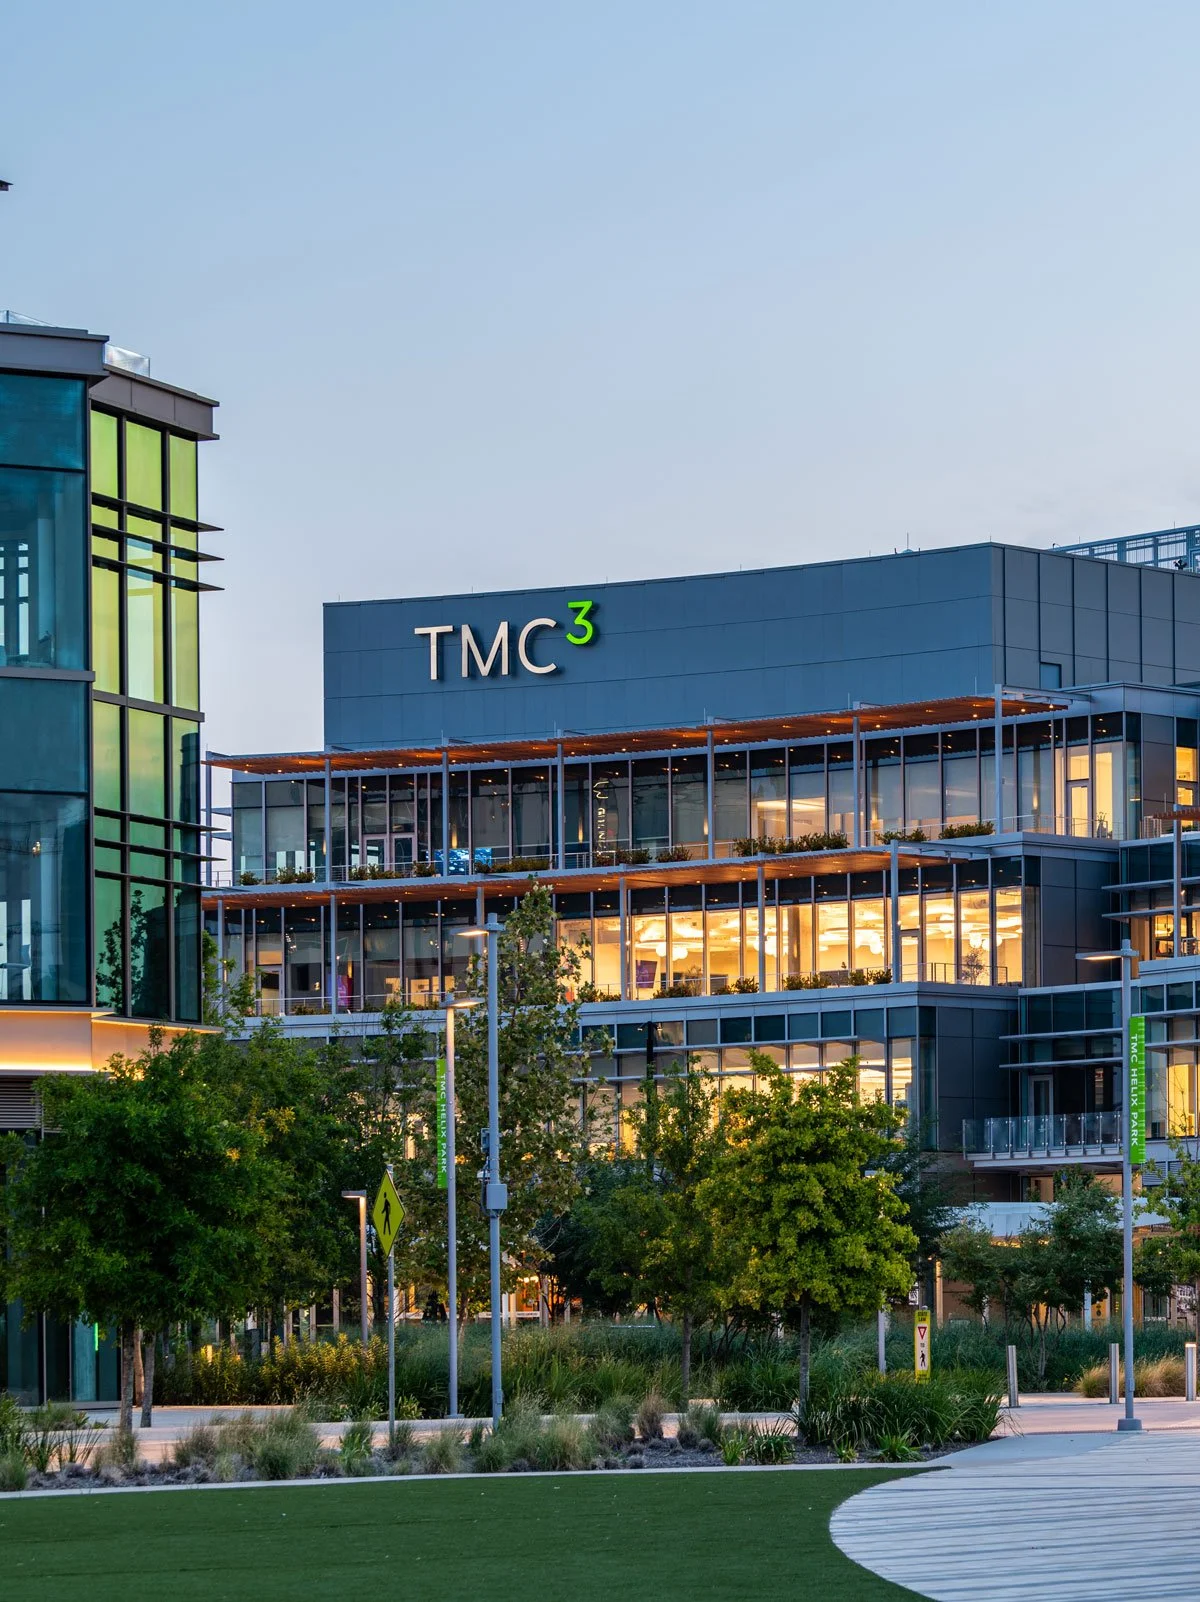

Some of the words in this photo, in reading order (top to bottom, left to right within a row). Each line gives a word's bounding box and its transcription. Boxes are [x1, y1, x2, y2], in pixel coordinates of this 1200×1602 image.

[1130, 1034, 1138, 1063] TMC
[1130, 1068, 1138, 1106] HELIX
[1131, 1112, 1139, 1146] PARK
